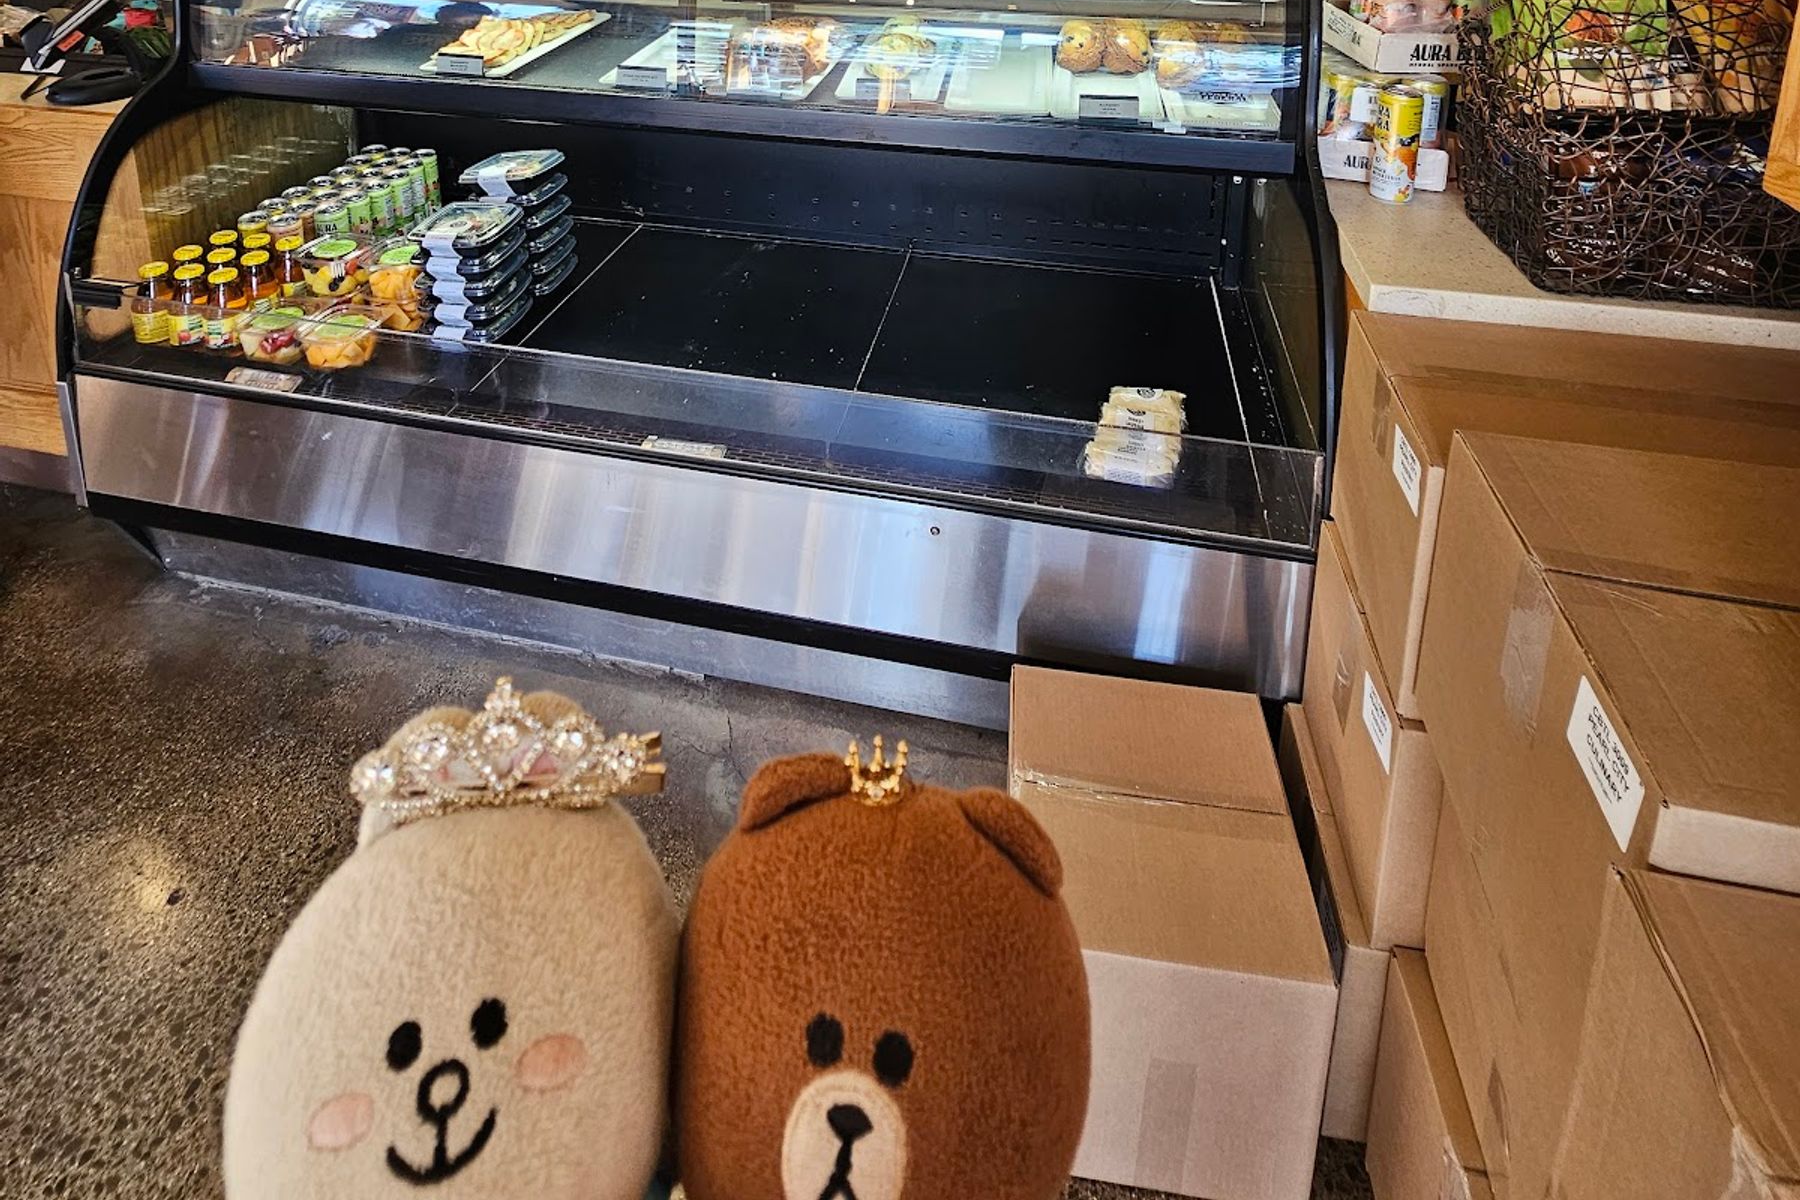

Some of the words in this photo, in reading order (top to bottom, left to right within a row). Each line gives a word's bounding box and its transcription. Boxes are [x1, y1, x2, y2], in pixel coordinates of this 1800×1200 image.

[1409, 43, 1452, 61] AURA
[1343, 154, 1372, 170] AUR
[1587, 733, 1623, 803] CULINARY
[1588, 713, 1612, 762] PEARL
[1612, 760, 1630, 793] CITY
